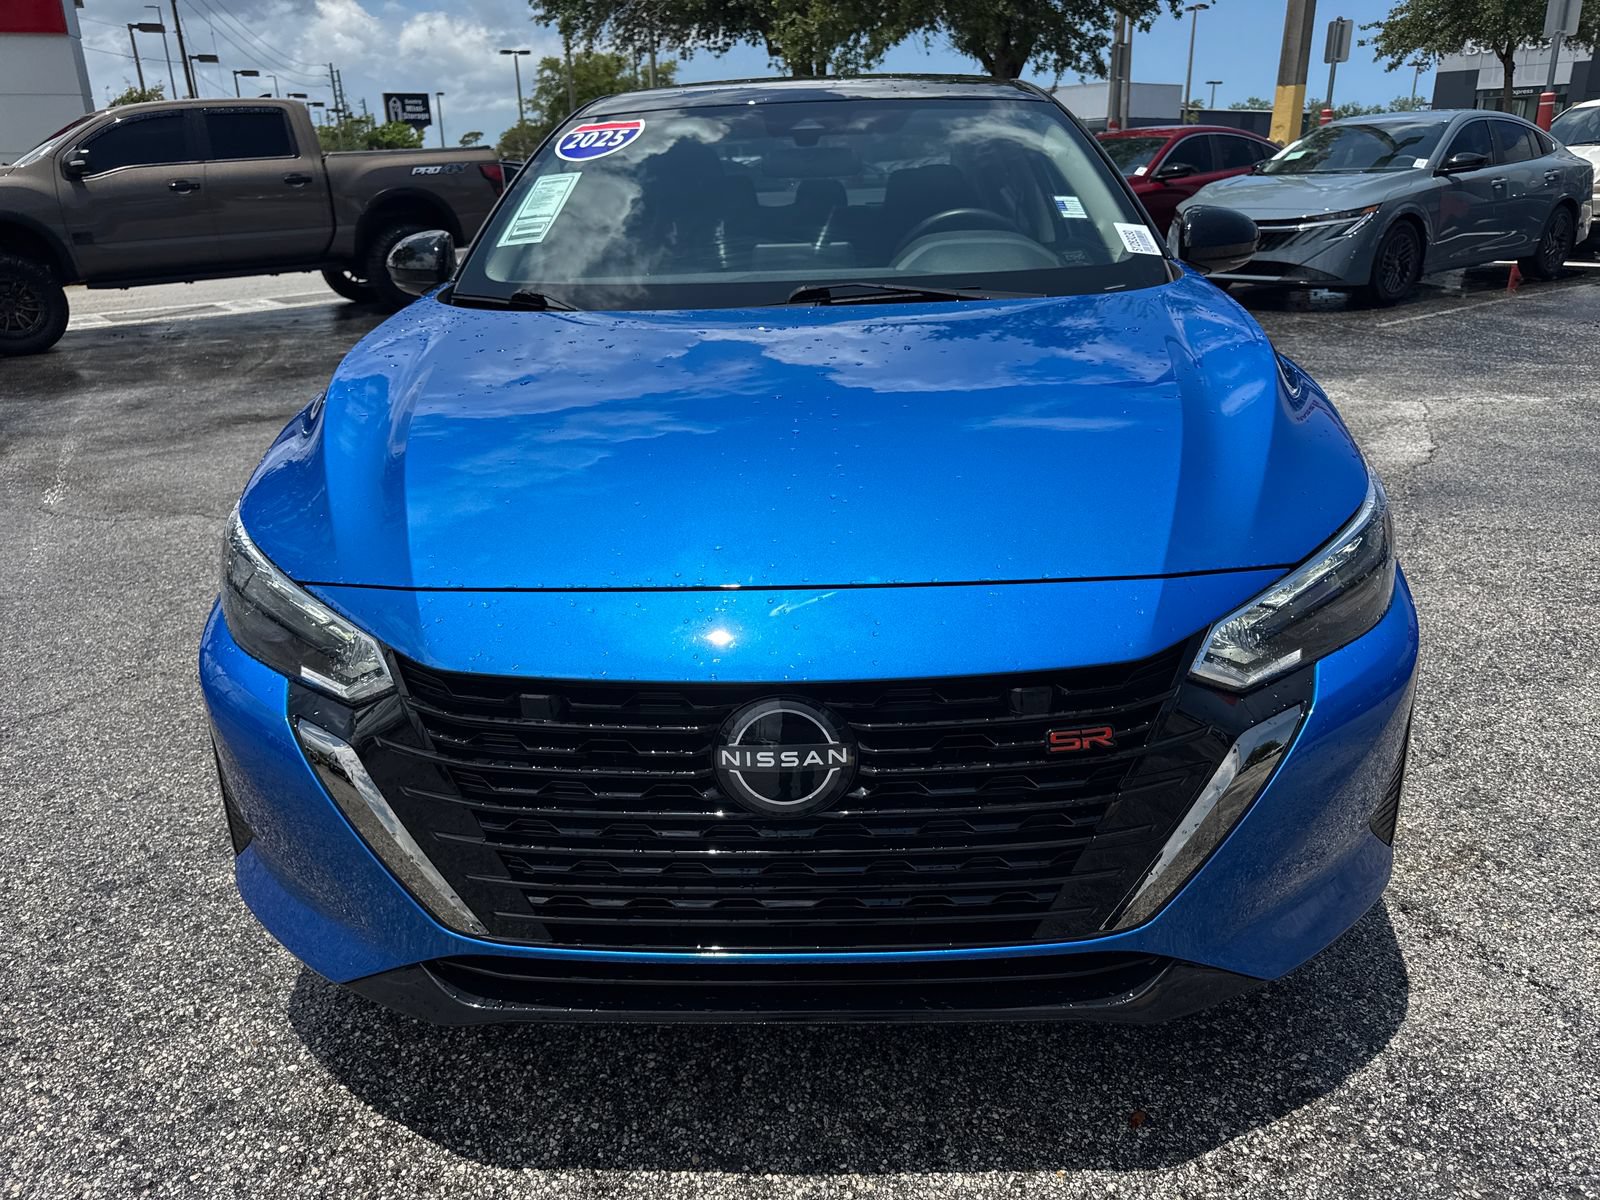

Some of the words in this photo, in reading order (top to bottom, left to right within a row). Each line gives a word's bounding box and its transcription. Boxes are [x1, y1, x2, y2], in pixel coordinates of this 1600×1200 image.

[403, 112, 430, 120] Storage
[562, 130, 630, 150] 2025
[1049, 726, 1114, 752] SR
[721, 747, 847, 767] NISSAN
